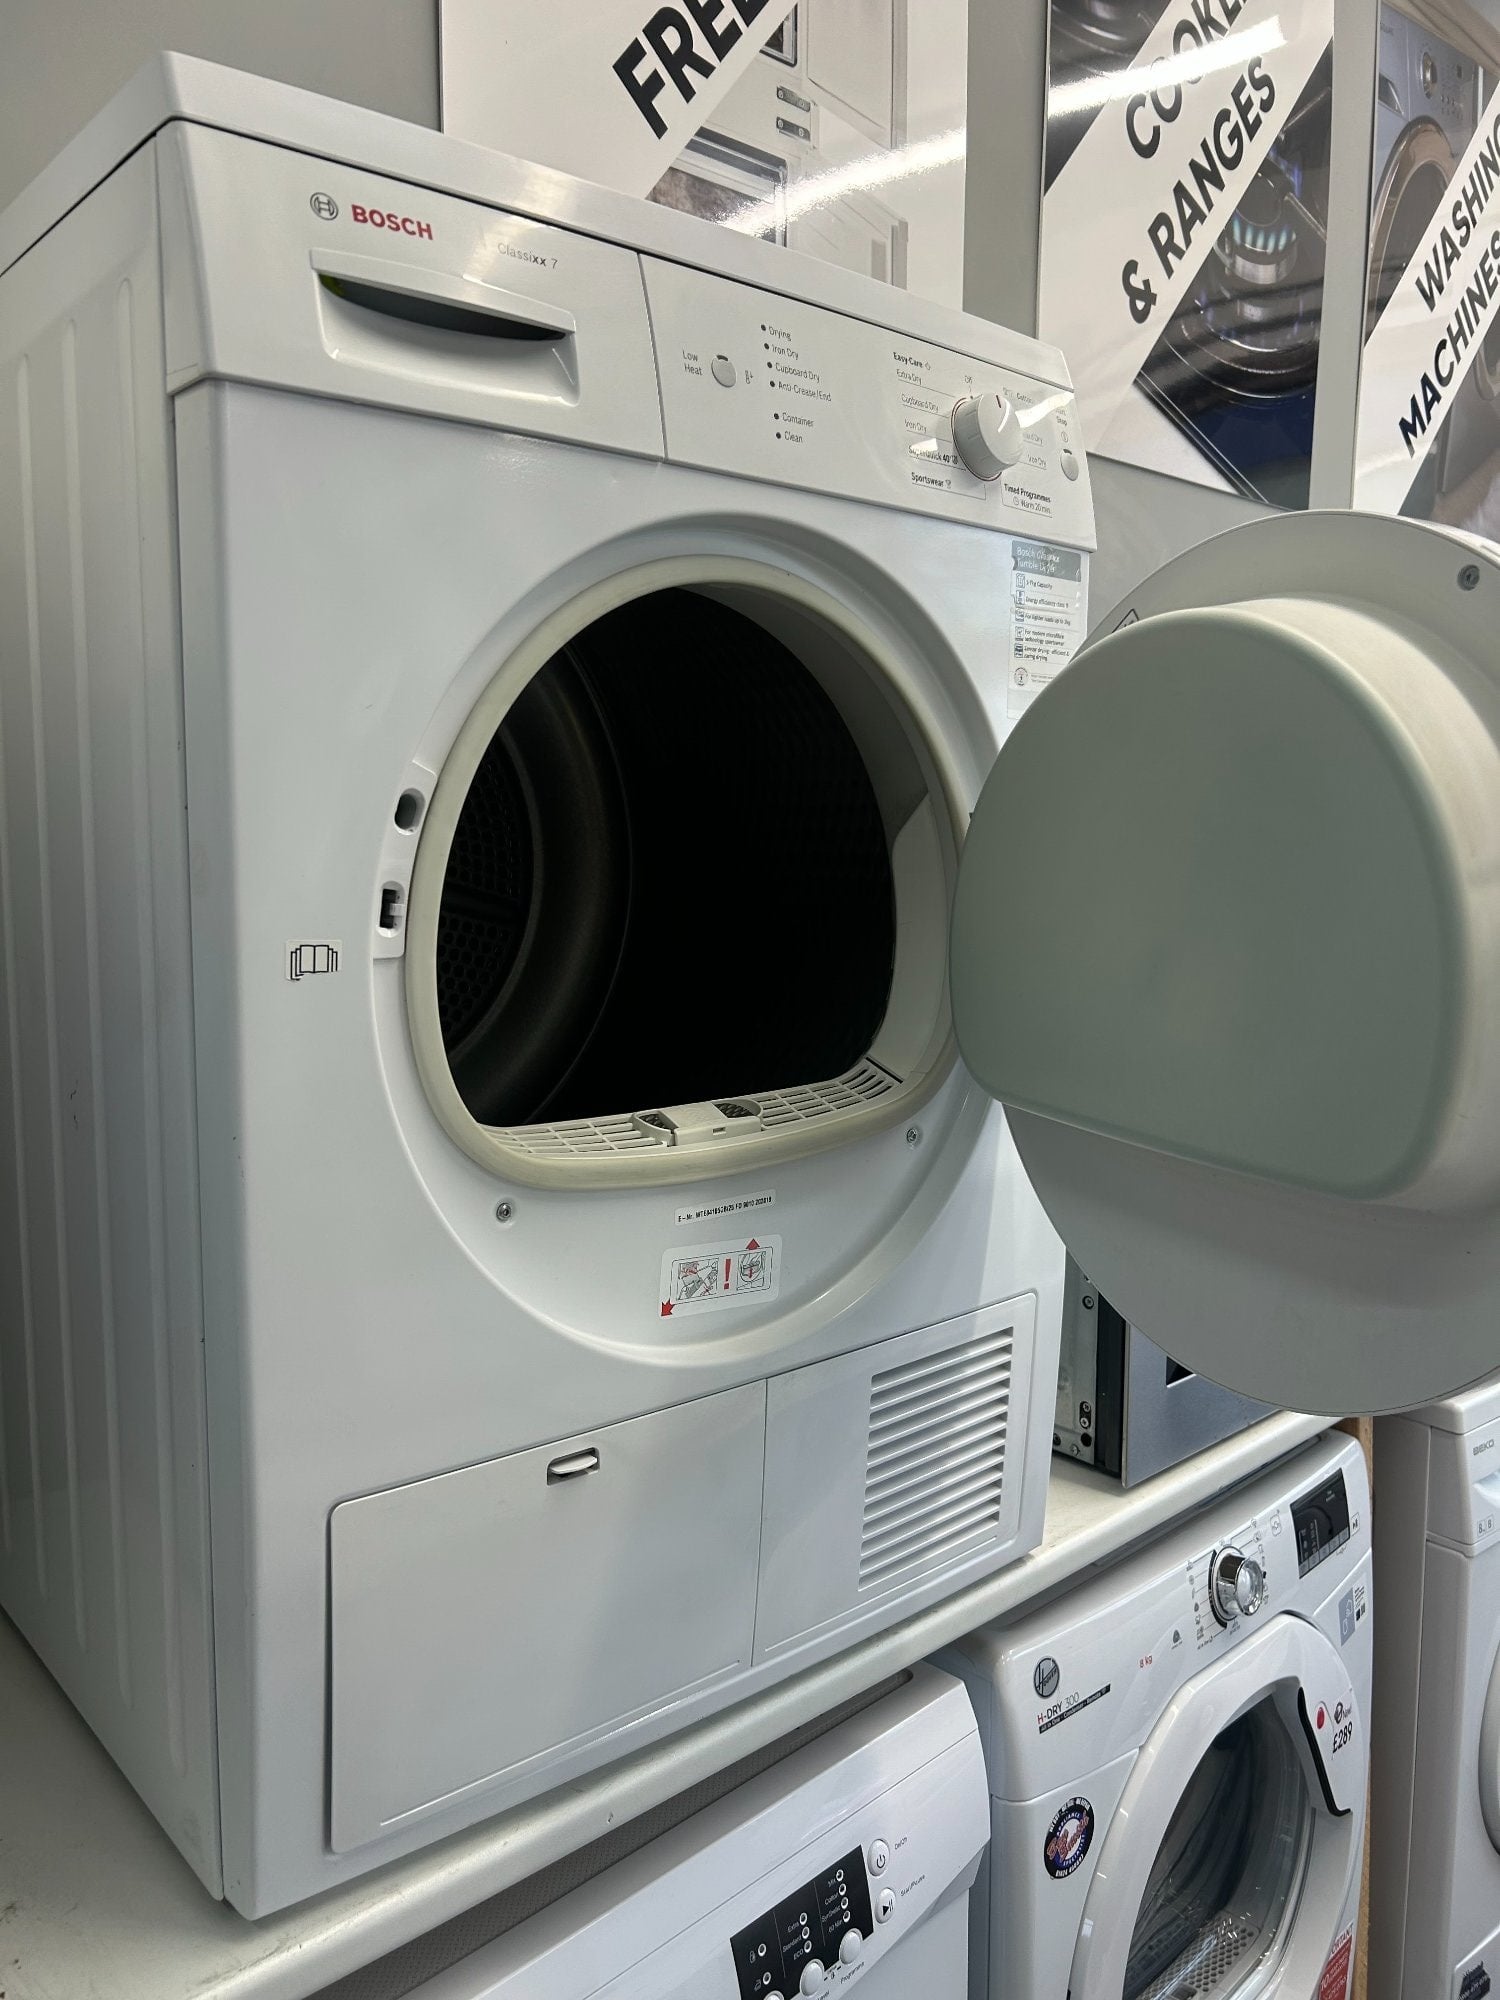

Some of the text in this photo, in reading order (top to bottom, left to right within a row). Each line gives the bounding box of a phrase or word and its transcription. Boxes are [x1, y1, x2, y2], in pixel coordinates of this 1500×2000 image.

[1122, 56, 1275, 324] & RANGES
[1415, 112, 1500, 313] WASHIN
[351, 204, 434, 241] BOSCH
[497, 242, 558, 269] Classixx 7
[768, 325, 792, 341] Drying
[682, 350, 699, 362] Low
[771, 343, 799, 360] Iron Dry
[684, 363, 703, 376] Heat
[775, 362, 820, 383] Cupboard Dry
[778, 380, 832, 401] Anti-Crease/End
[782, 411, 814, 427] Container
[784, 430, 804, 443] Clean
[911, 472, 944, 488] Sportswear
[1004, 483, 1051, 504] Timed Programmes
[1472, 1439, 1495, 1456] BEKO
[1139, 1655, 1153, 1669] 8 kg
[1037, 1692, 1080, 1725] H-DRY 300
[1333, 1721, 1353, 1754] £289
[793, 1948, 804, 1961] ECO
